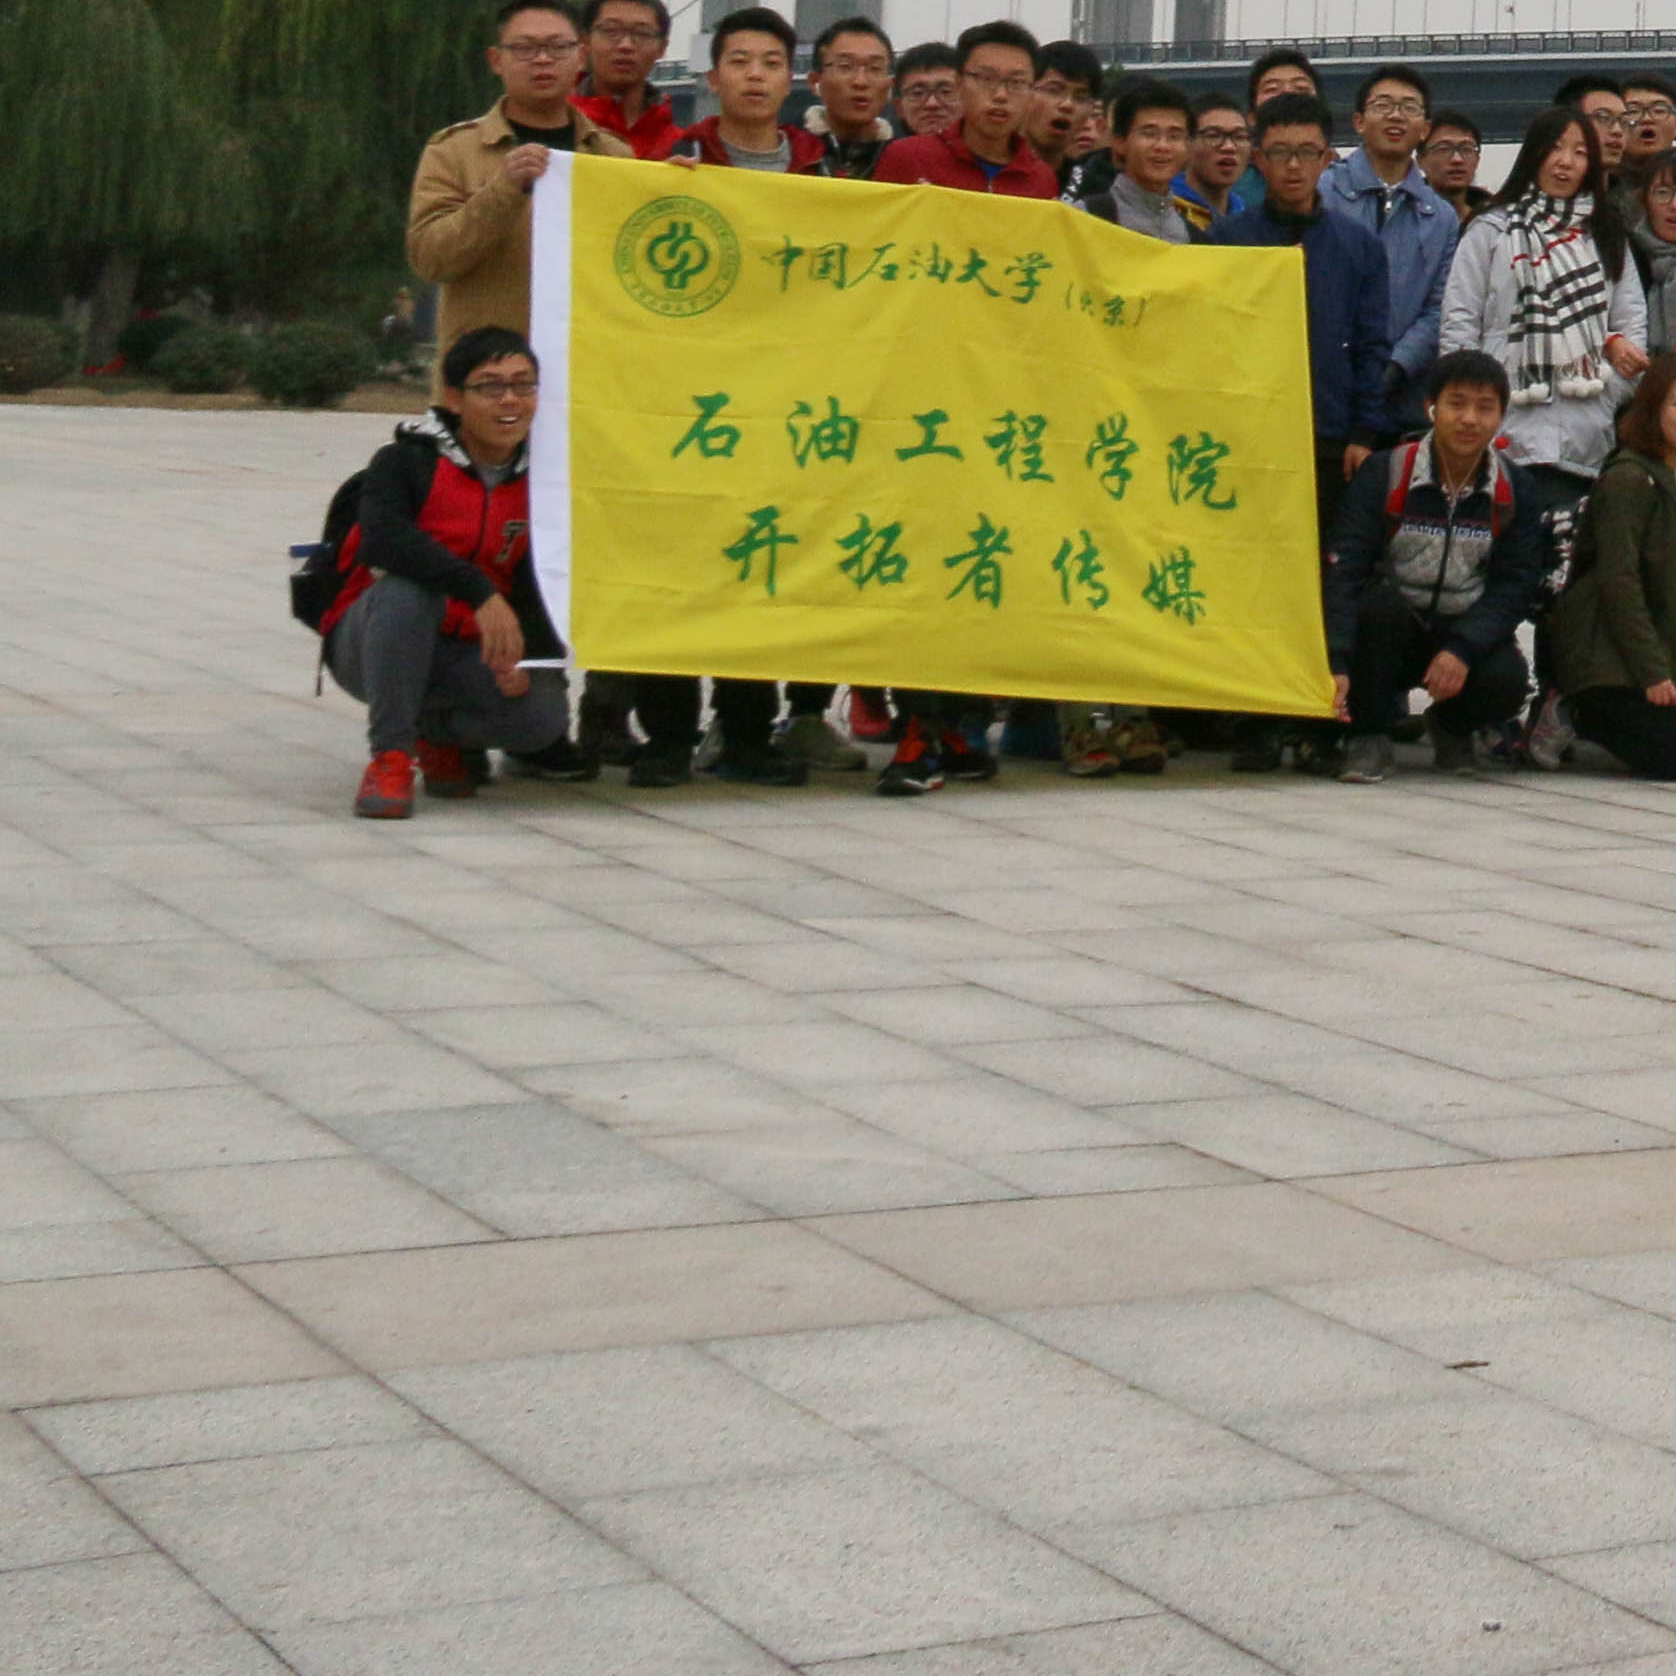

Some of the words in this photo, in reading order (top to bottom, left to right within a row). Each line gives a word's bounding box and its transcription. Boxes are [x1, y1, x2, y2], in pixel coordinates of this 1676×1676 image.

[671, 392, 1238, 511] 石油工程学院
[721, 505, 1207, 626] 开拓者传媒
